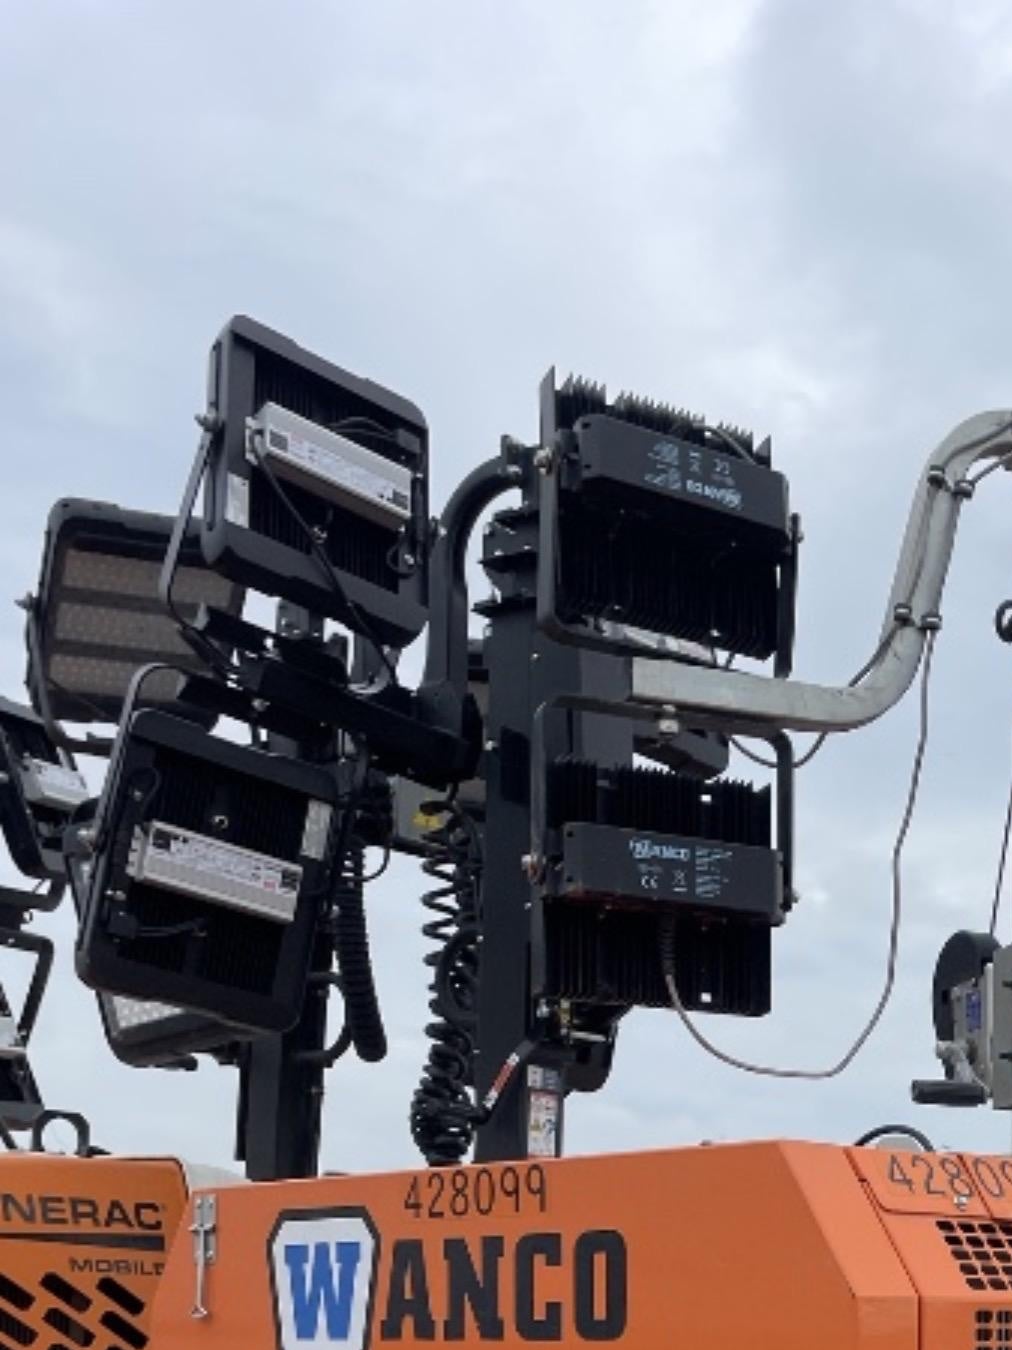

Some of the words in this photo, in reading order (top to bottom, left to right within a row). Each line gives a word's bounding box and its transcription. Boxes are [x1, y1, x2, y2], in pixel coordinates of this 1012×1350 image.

[1, 1193, 163, 1231] NERAC
[403, 1164, 548, 1219] 428099
[283, 1229, 628, 1341] WANCO
